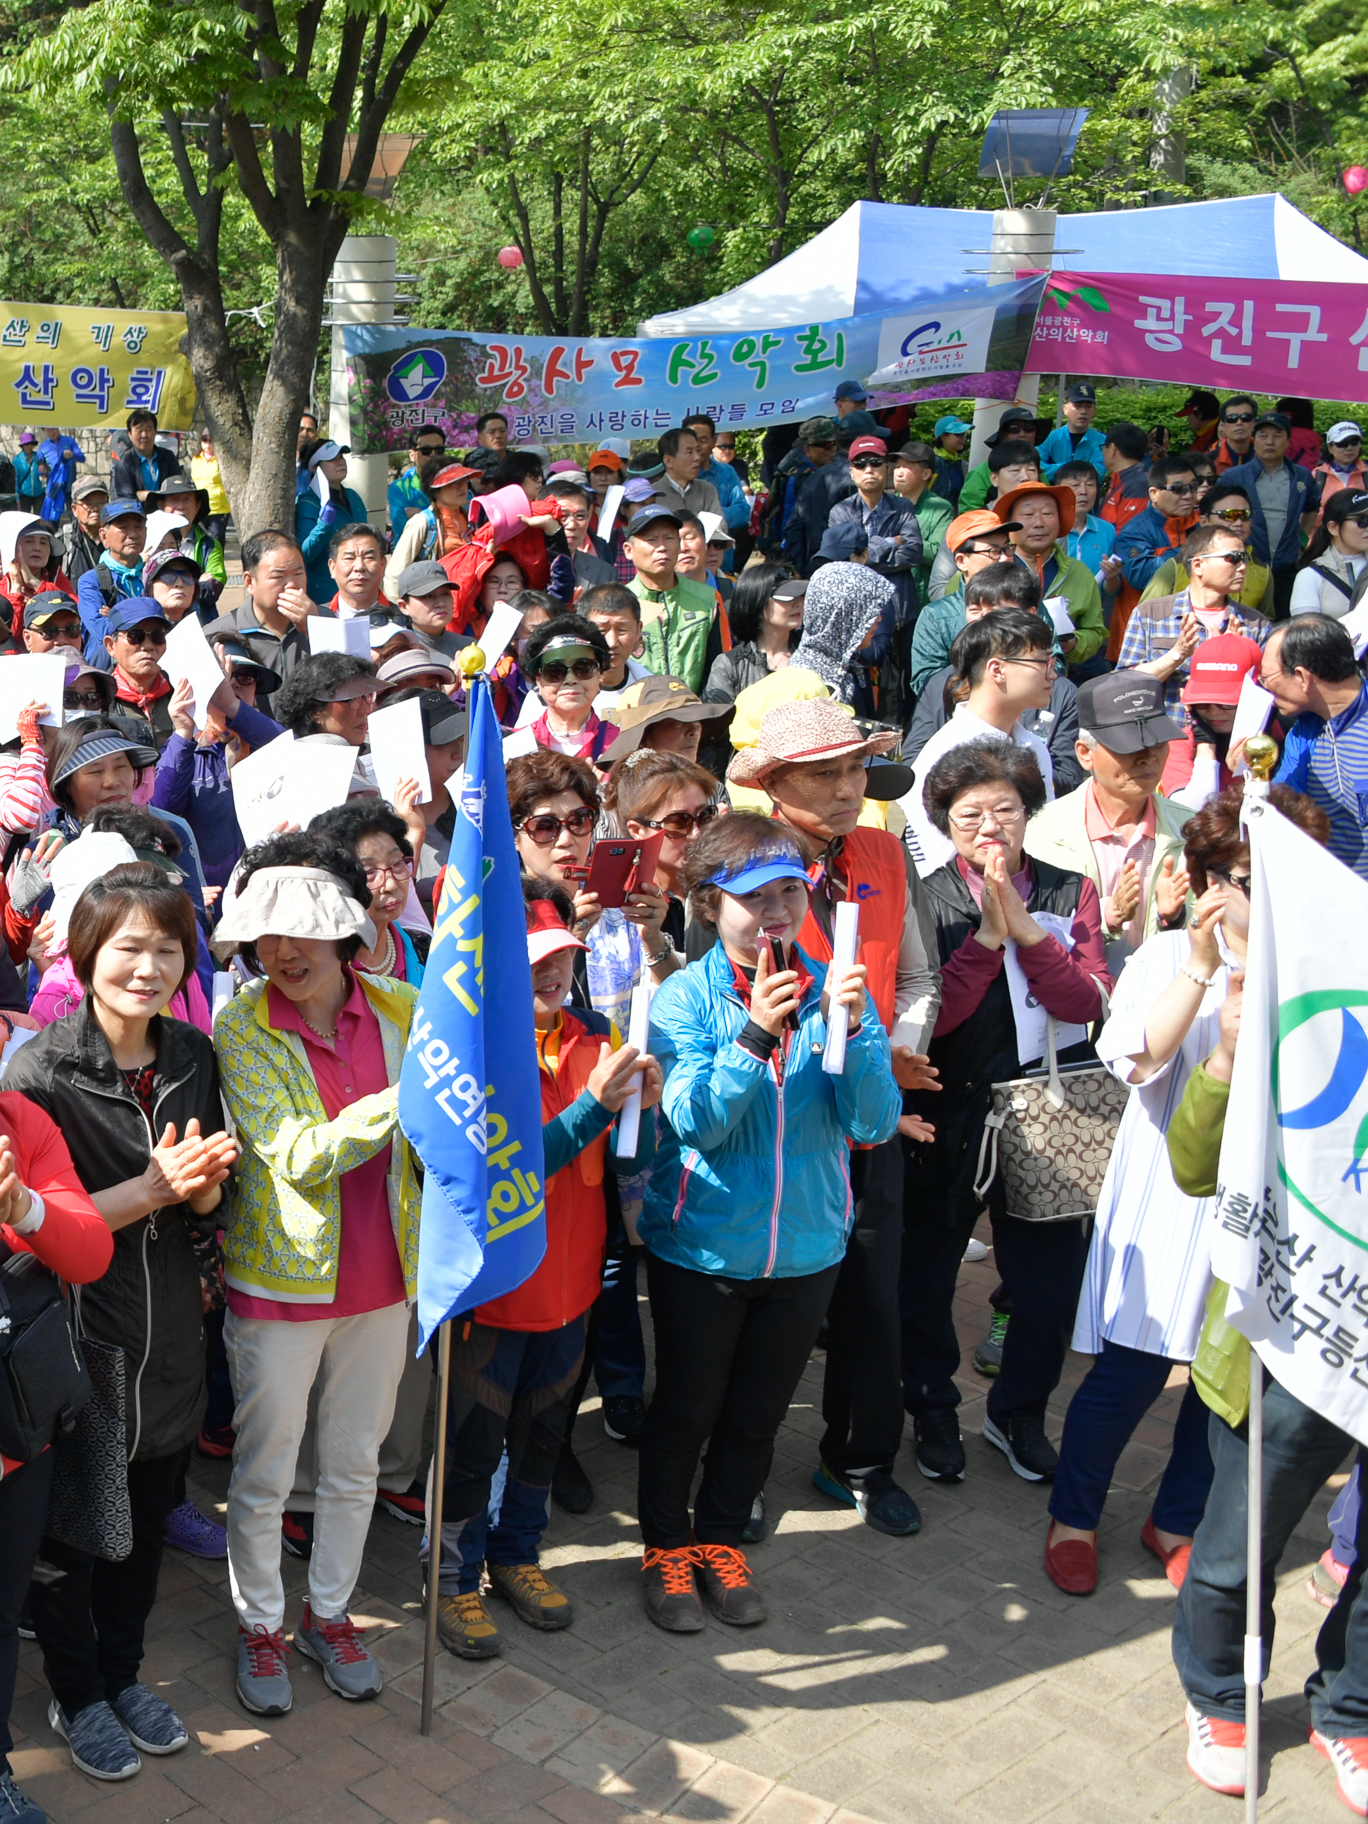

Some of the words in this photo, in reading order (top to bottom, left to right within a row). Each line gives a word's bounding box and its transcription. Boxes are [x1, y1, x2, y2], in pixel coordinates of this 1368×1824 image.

[91, 323, 148, 354] 기상
[1133, 295, 1328, 369] 광진구
[475, 343, 646, 401] 광사모
[666, 323, 846, 391] 산악회
[387, 407, 448, 428] 광진구
[513, 412, 577, 439] 광진을
[585, 408, 672, 433] 사랑하는
[755, 397, 801, 418] 모임
